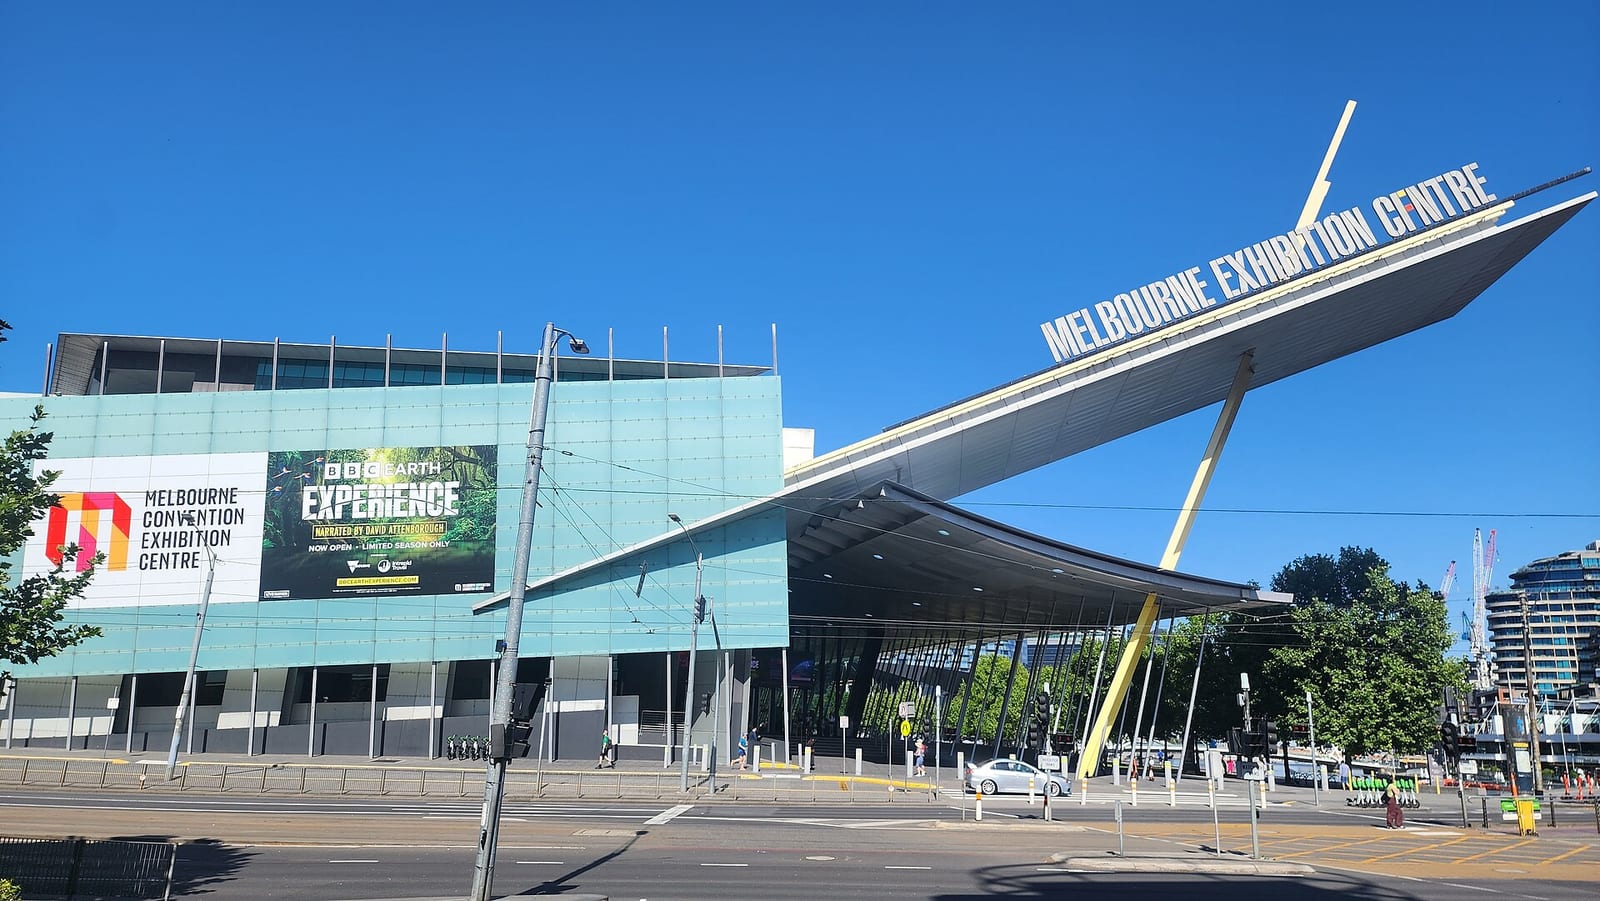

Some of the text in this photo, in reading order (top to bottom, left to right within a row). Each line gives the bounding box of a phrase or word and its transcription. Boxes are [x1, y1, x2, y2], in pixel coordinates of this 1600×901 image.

[1040, 162, 1497, 363] MELBOURNE EXHIBITION CENTRE
[327, 462, 441, 478] BBC EARTH
[145, 487, 238, 507] MELBOURNE
[301, 481, 460, 520] EXPERIENCE
[143, 508, 244, 528] CONVENTION
[141, 529, 231, 549] EXHIBITION
[315, 521, 444, 537] NARRATED BY DAVID ATTENBOROUGH
[308, 540, 450, 553] NOW OPEN LIMITED SEASON ONLY
[139, 552, 200, 571] CENTRE
